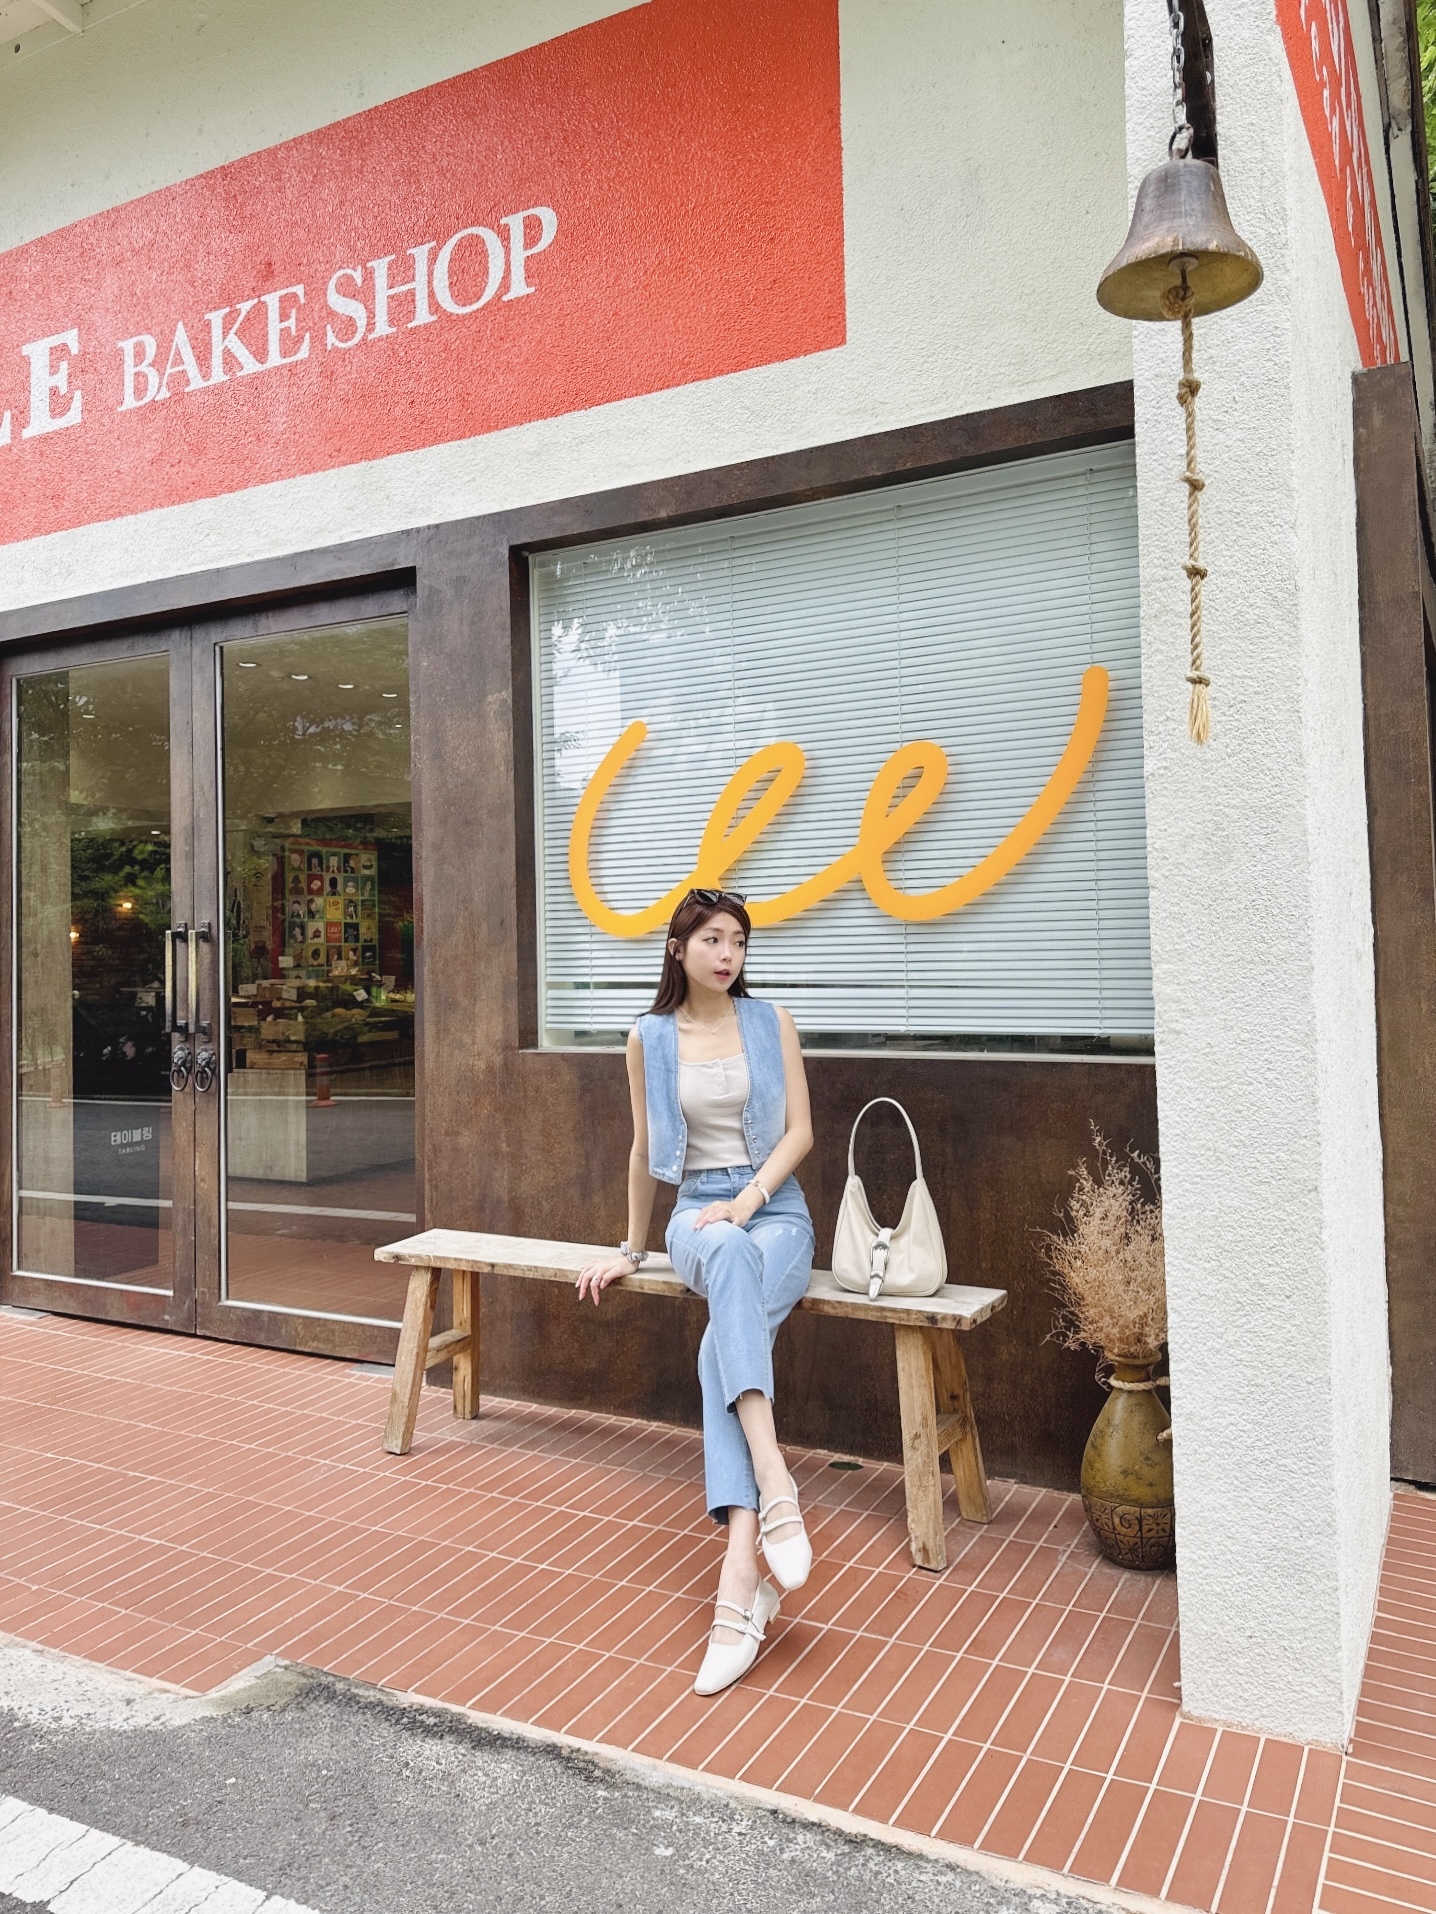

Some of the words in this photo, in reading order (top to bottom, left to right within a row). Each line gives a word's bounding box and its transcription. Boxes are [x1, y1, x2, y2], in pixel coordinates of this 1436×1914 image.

[0, 327, 83, 448] E
[116, 284, 311, 413] BAKE
[326, 206, 559, 351] SHOP
[111, 1126, 152, 1145] 테이블링
[118, 1145, 146, 1154] TABLING
